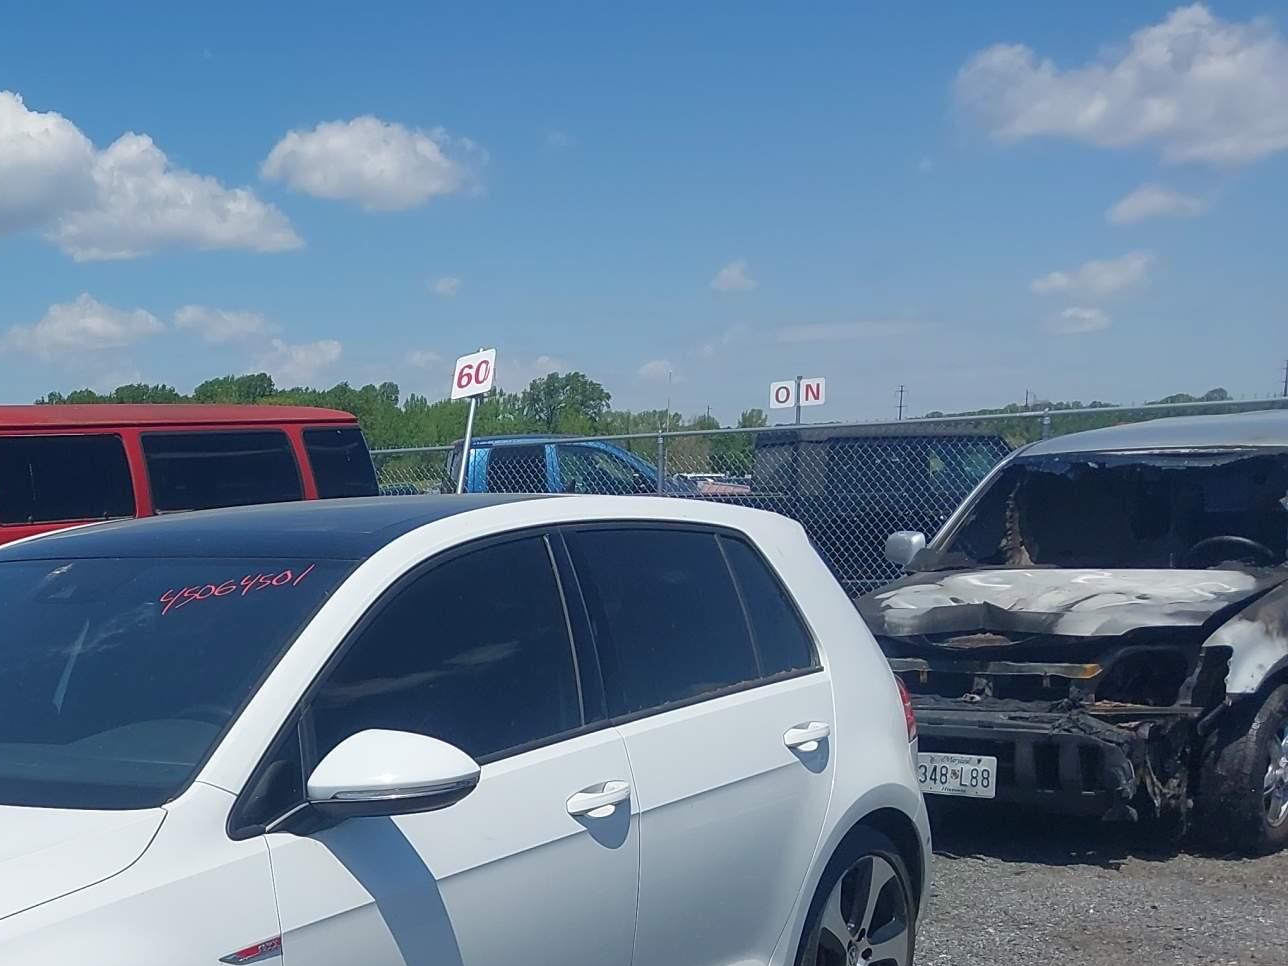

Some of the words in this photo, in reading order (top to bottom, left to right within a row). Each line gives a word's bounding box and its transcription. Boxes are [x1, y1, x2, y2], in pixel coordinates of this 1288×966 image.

[457, 359, 490, 389] 60
[804, 383, 820, 402] N
[160, 564, 316, 616] 45064501
[918, 764, 949, 785] 348
[959, 766, 991, 788] L88
